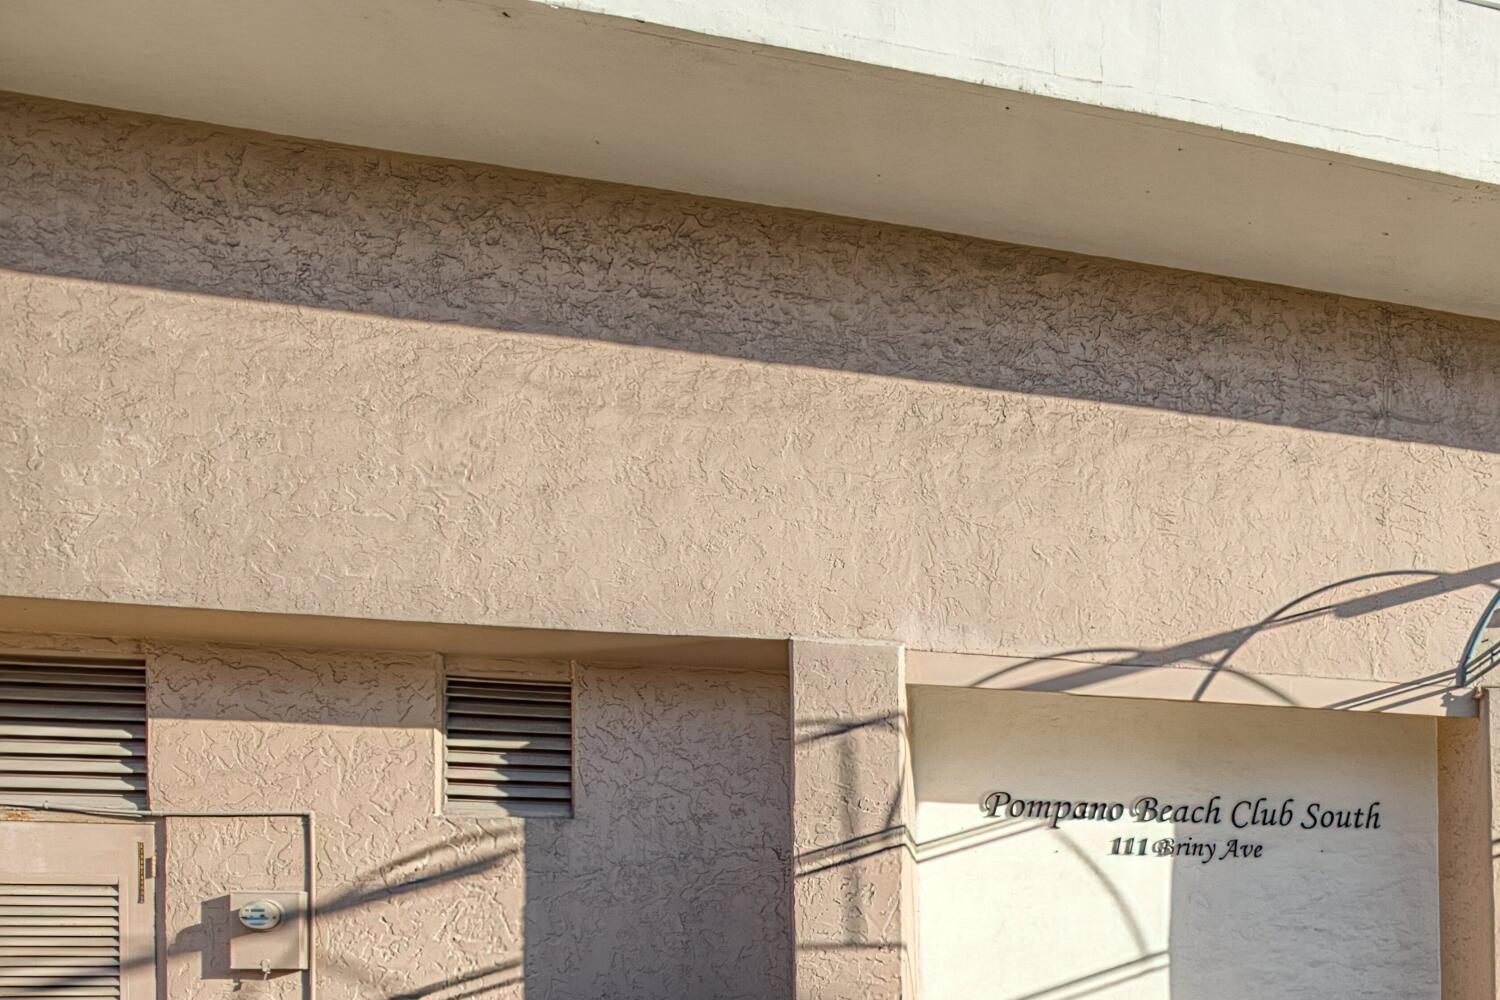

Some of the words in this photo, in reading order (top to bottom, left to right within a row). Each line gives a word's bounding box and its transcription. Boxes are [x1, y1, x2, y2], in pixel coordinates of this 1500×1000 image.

[984, 791, 1125, 830] Pompano
[1134, 796, 1222, 824] Beach
[1230, 798, 1295, 829] Club
[1300, 802, 1382, 830] South
[1109, 836, 1149, 856] 111
[1152, 837, 1216, 865] Briny
[1218, 838, 1264, 861] Ave
